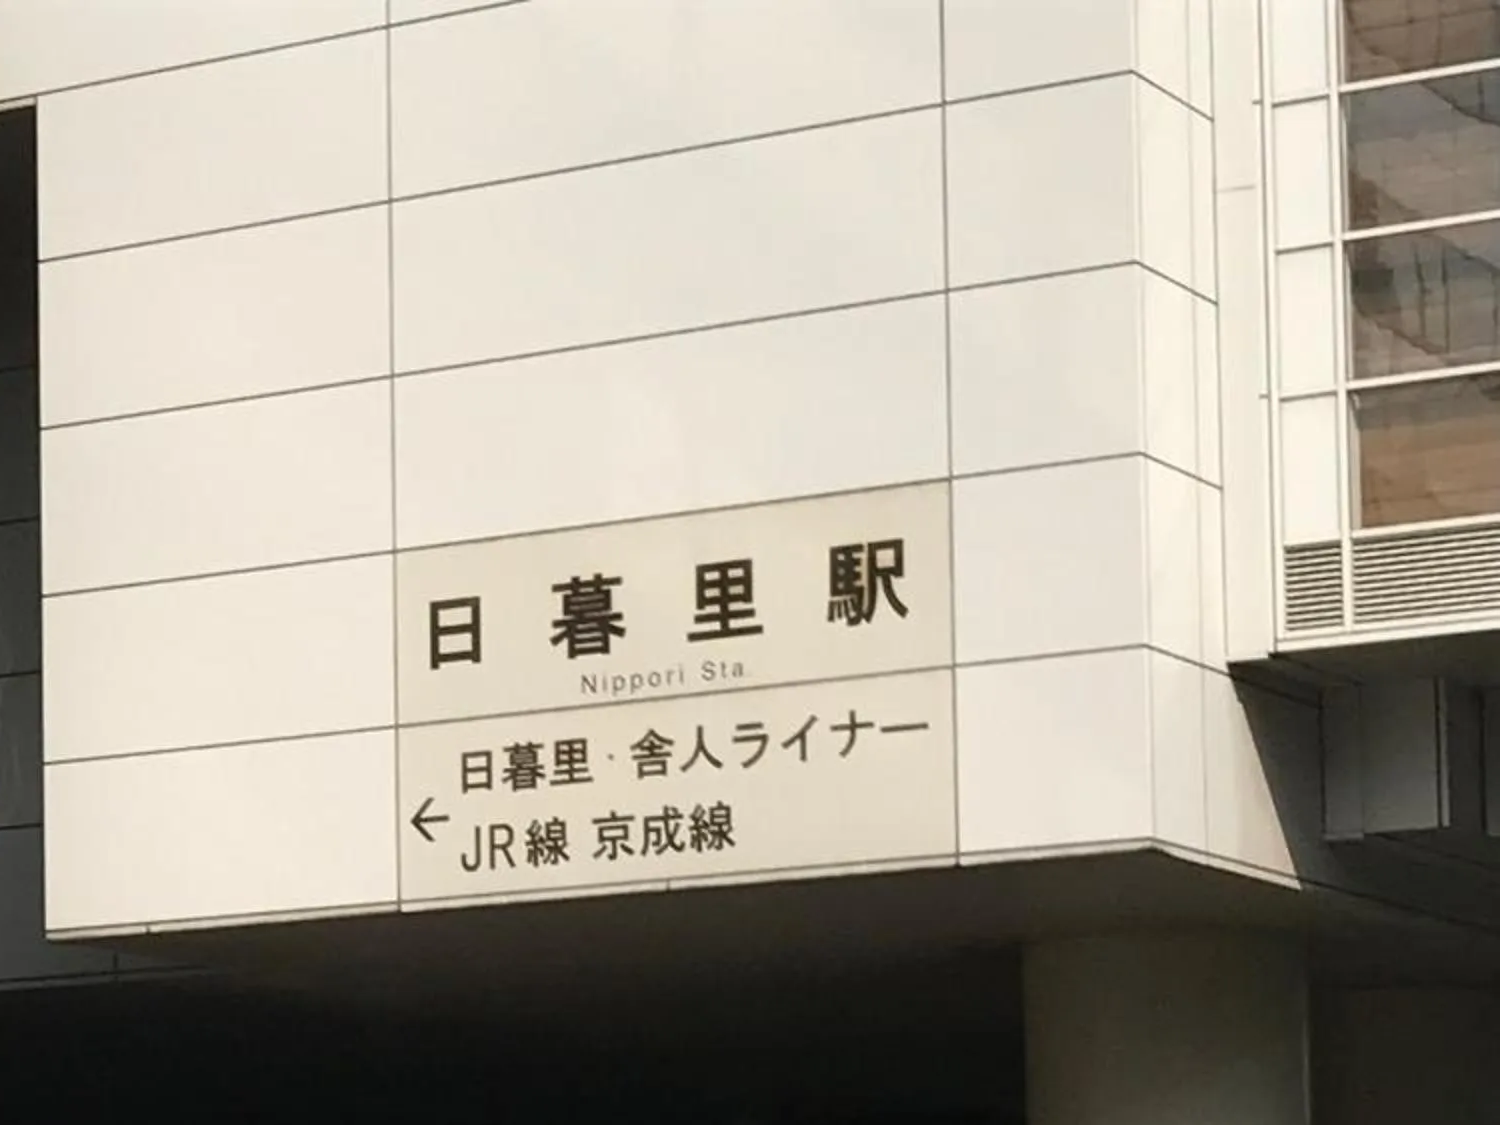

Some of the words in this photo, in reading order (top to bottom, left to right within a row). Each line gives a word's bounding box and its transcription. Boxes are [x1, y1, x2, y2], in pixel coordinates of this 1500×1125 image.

[428, 538, 908, 670] 日暮里駅
[580, 663, 685, 696] Nippori
[461, 819, 570, 873] JR線
[592, 801, 736, 863] 京成線
